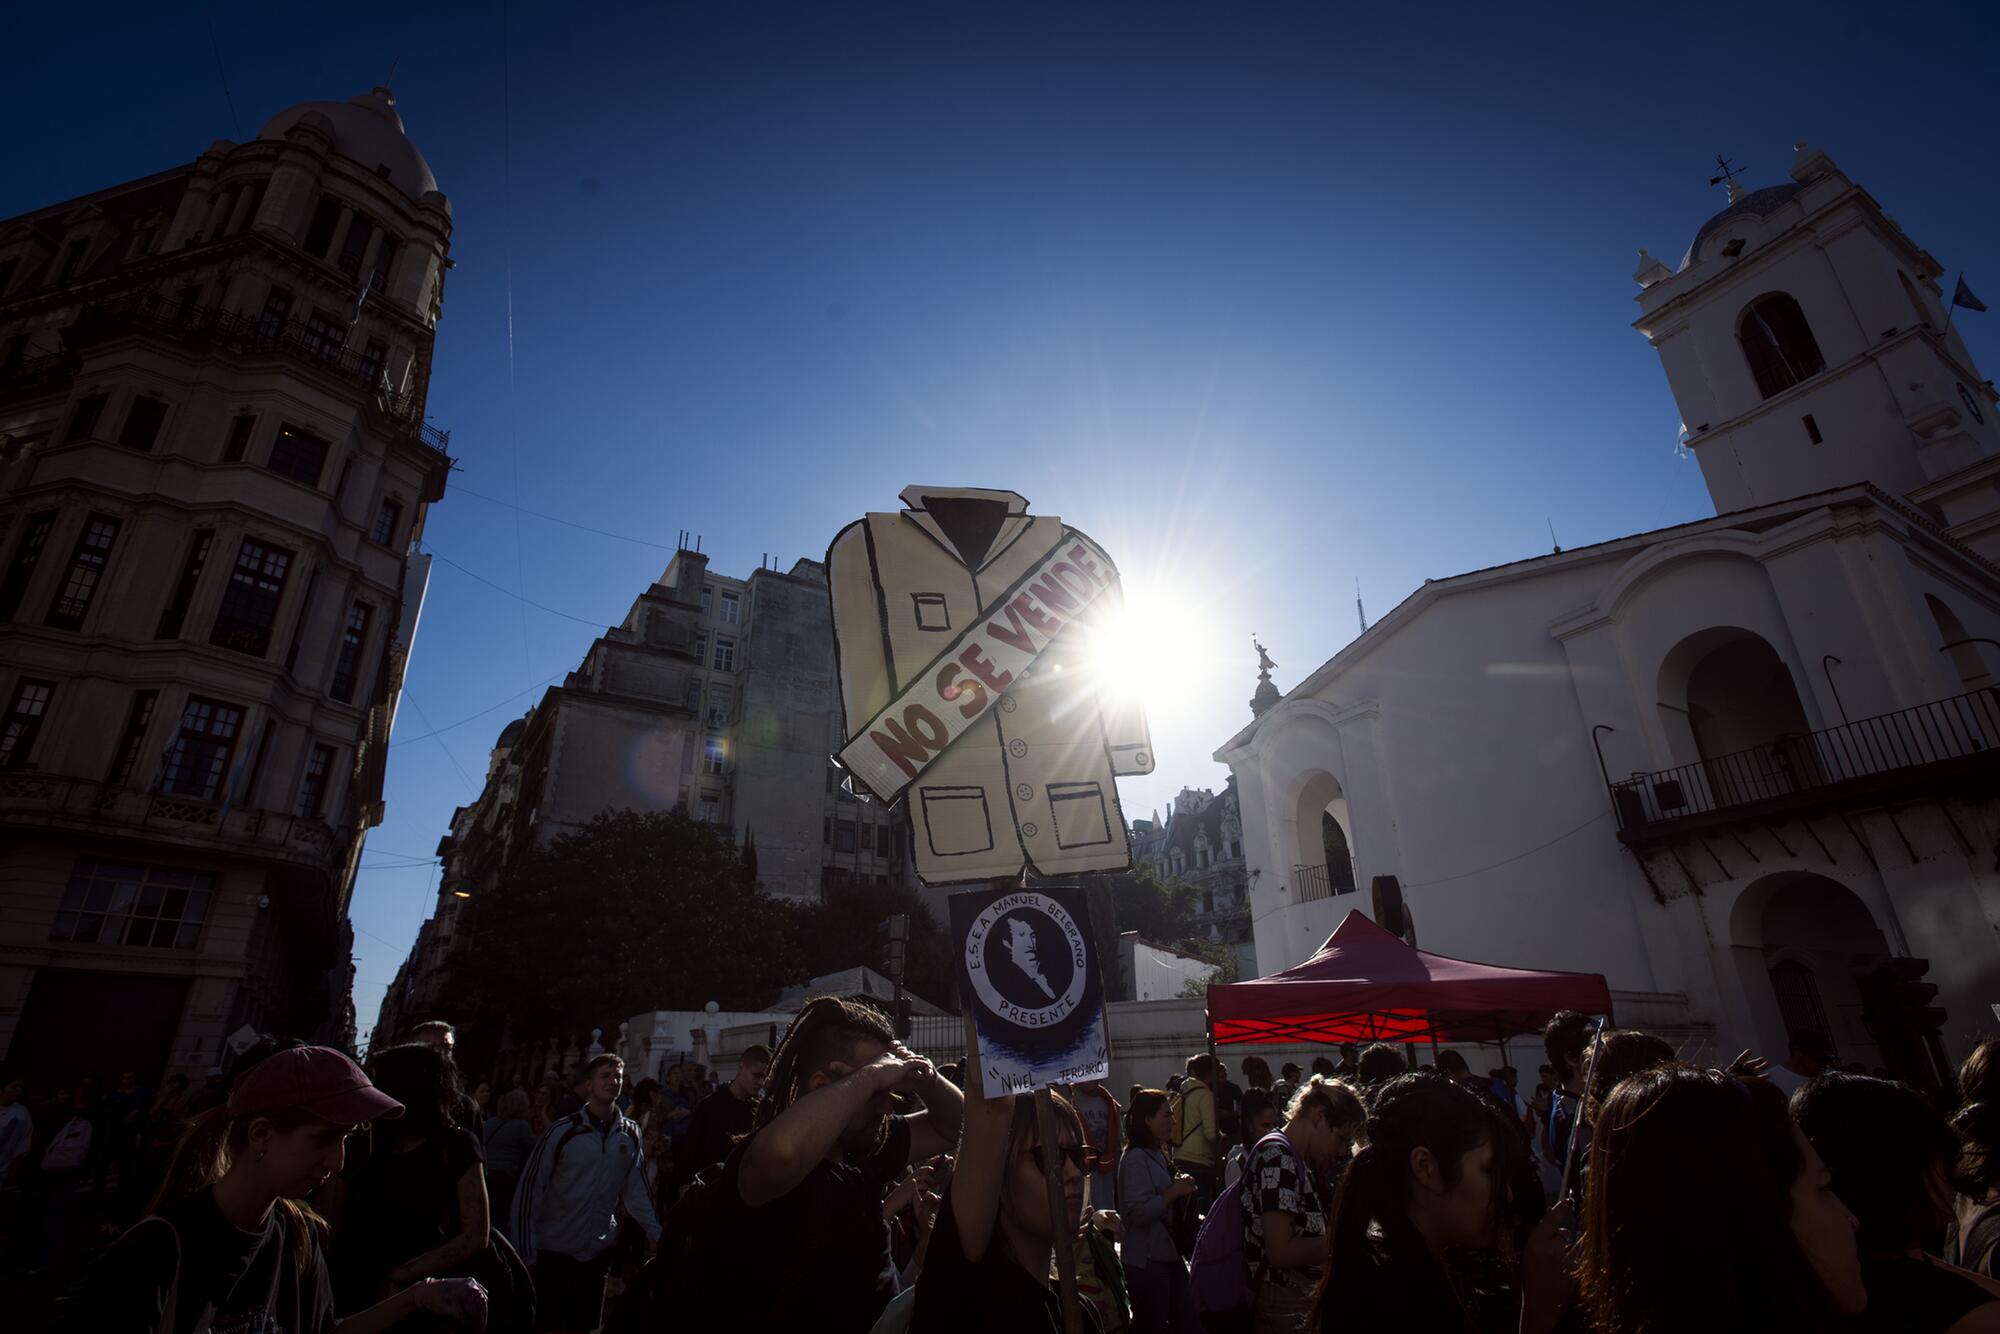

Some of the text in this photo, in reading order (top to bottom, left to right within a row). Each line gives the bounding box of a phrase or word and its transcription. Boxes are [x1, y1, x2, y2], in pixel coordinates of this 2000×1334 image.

[871, 544, 1114, 778] NO SE VENDE
[992, 895, 1041, 915] MANUEL
[1047, 903, 1084, 968] BELGRANO
[999, 994, 1075, 1025] PRESENTE
